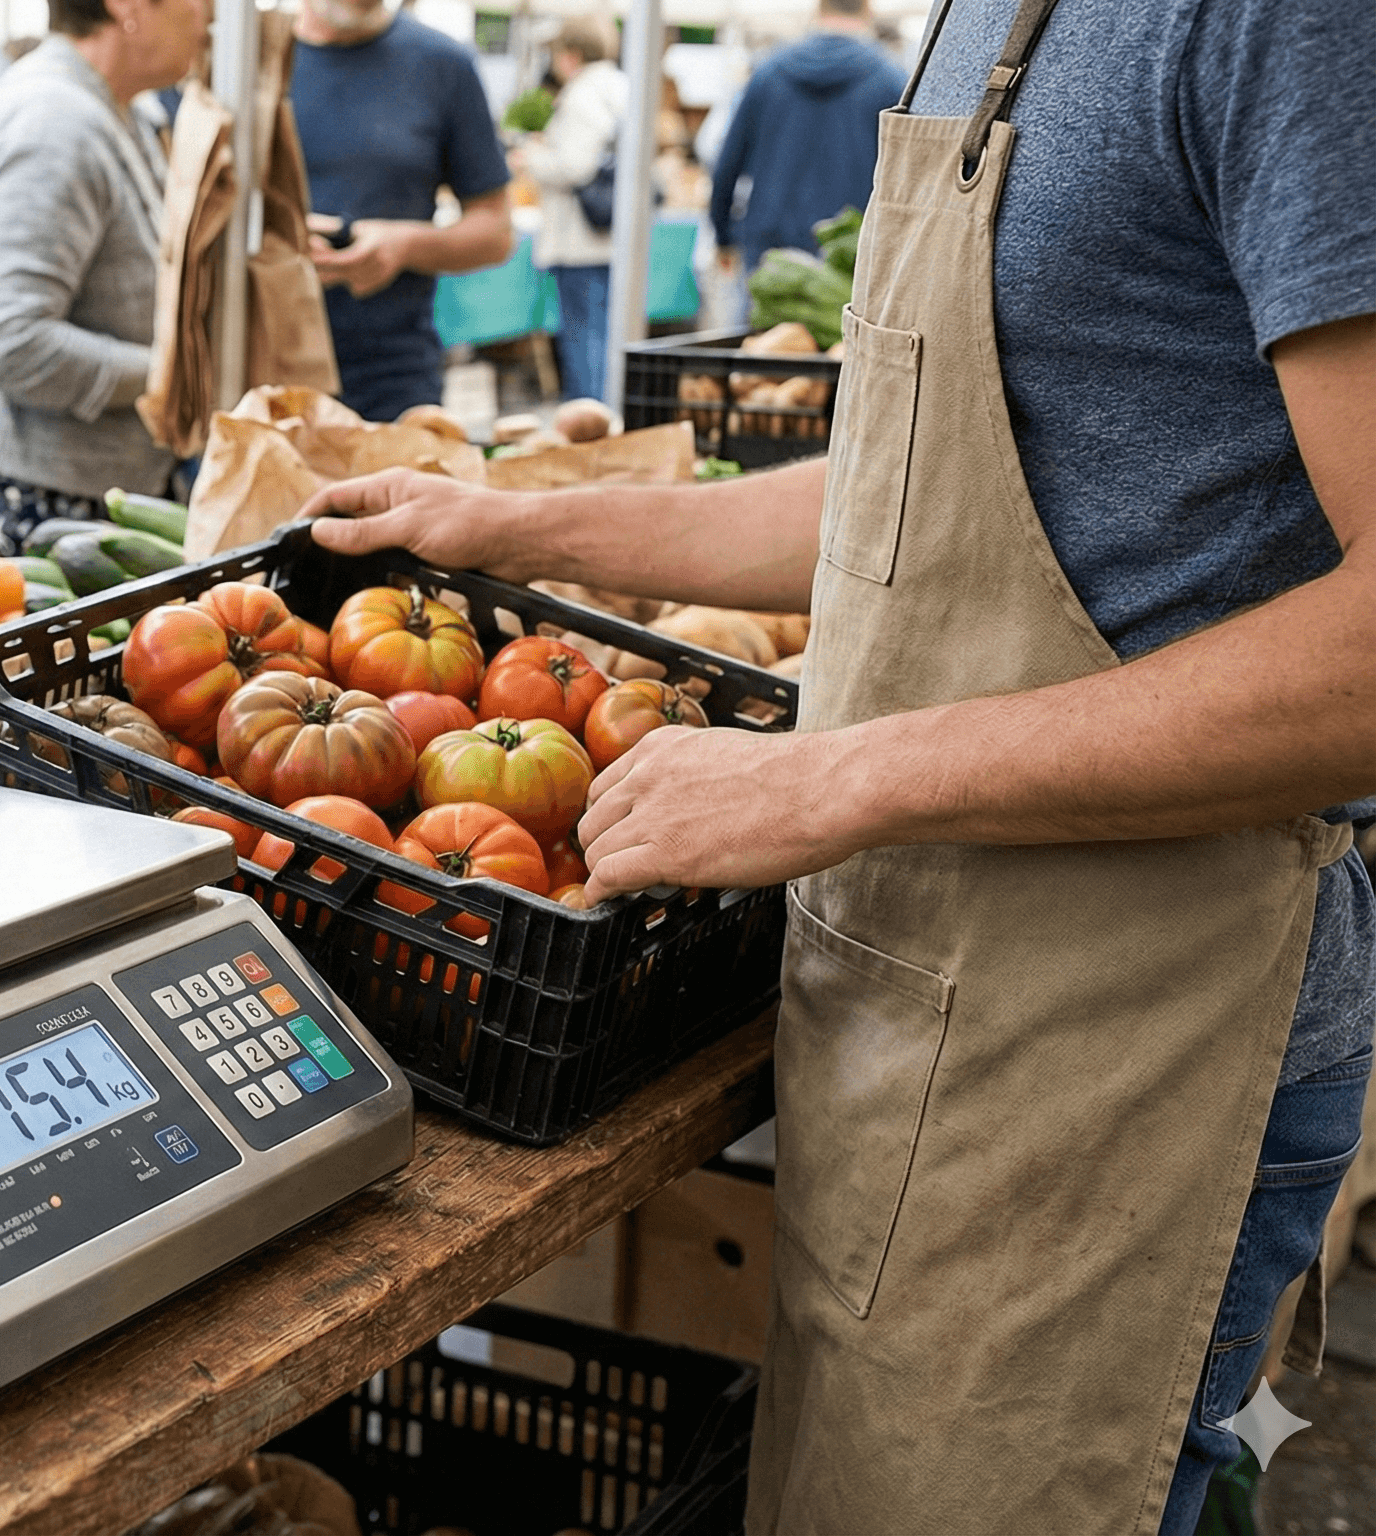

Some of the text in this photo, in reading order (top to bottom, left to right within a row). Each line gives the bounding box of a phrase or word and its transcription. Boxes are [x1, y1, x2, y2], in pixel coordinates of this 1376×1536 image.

[162, 971, 234, 1011] 7 8 9
[195, 1002, 261, 1041] 4 5 6
[220, 1058, 235, 1075] 1
[246, 1046, 263, 1063] 2
[273, 1034, 289, 1051] 3
[106, 1081, 140, 1101] kg
[248, 1092, 264, 1109] 0
